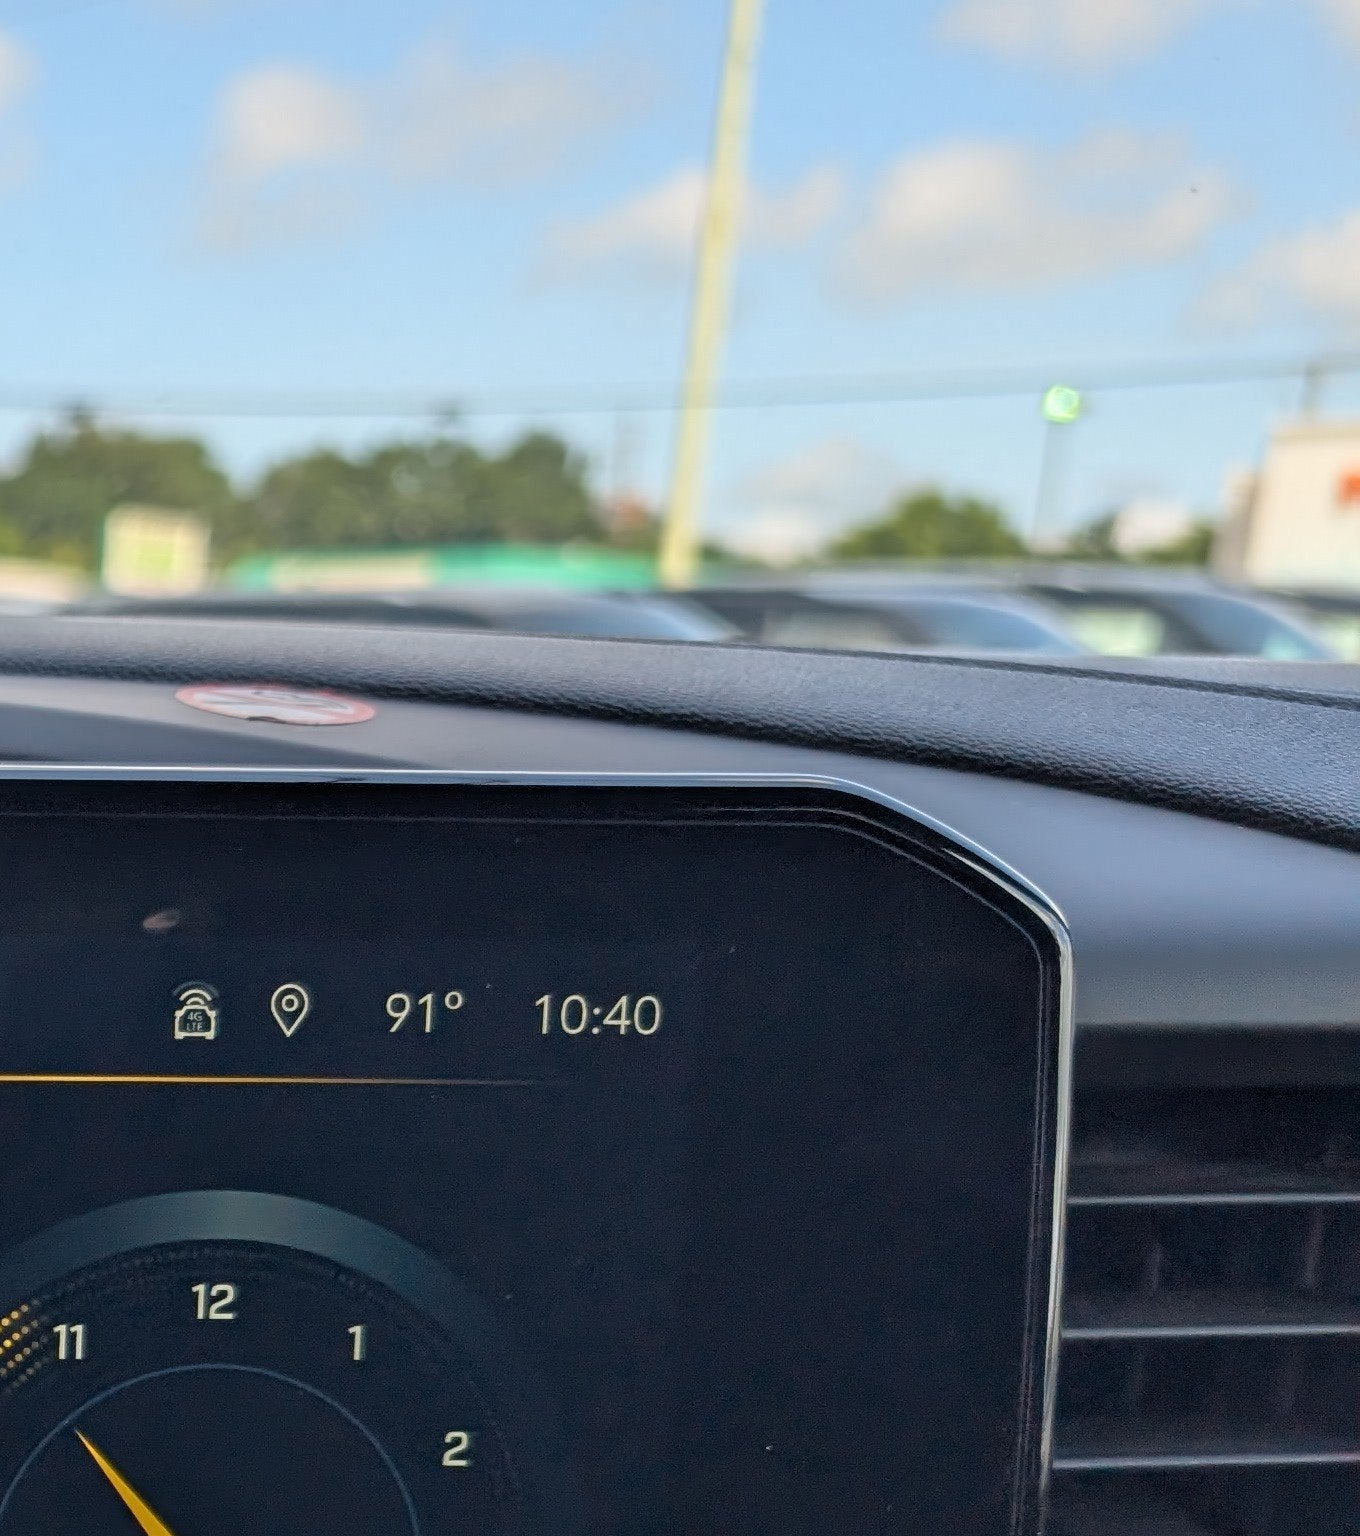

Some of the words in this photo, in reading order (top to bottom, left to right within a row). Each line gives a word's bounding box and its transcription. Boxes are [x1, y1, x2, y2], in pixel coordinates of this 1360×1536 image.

[187, 1011, 203, 1021] 4G
[534, 993, 662, 1037] 10:40
[191, 1283, 237, 1321] 12
[53, 1324, 85, 1361] 11
[347, 1325, 365, 1361] 1
[441, 1431, 470, 1468] 2
